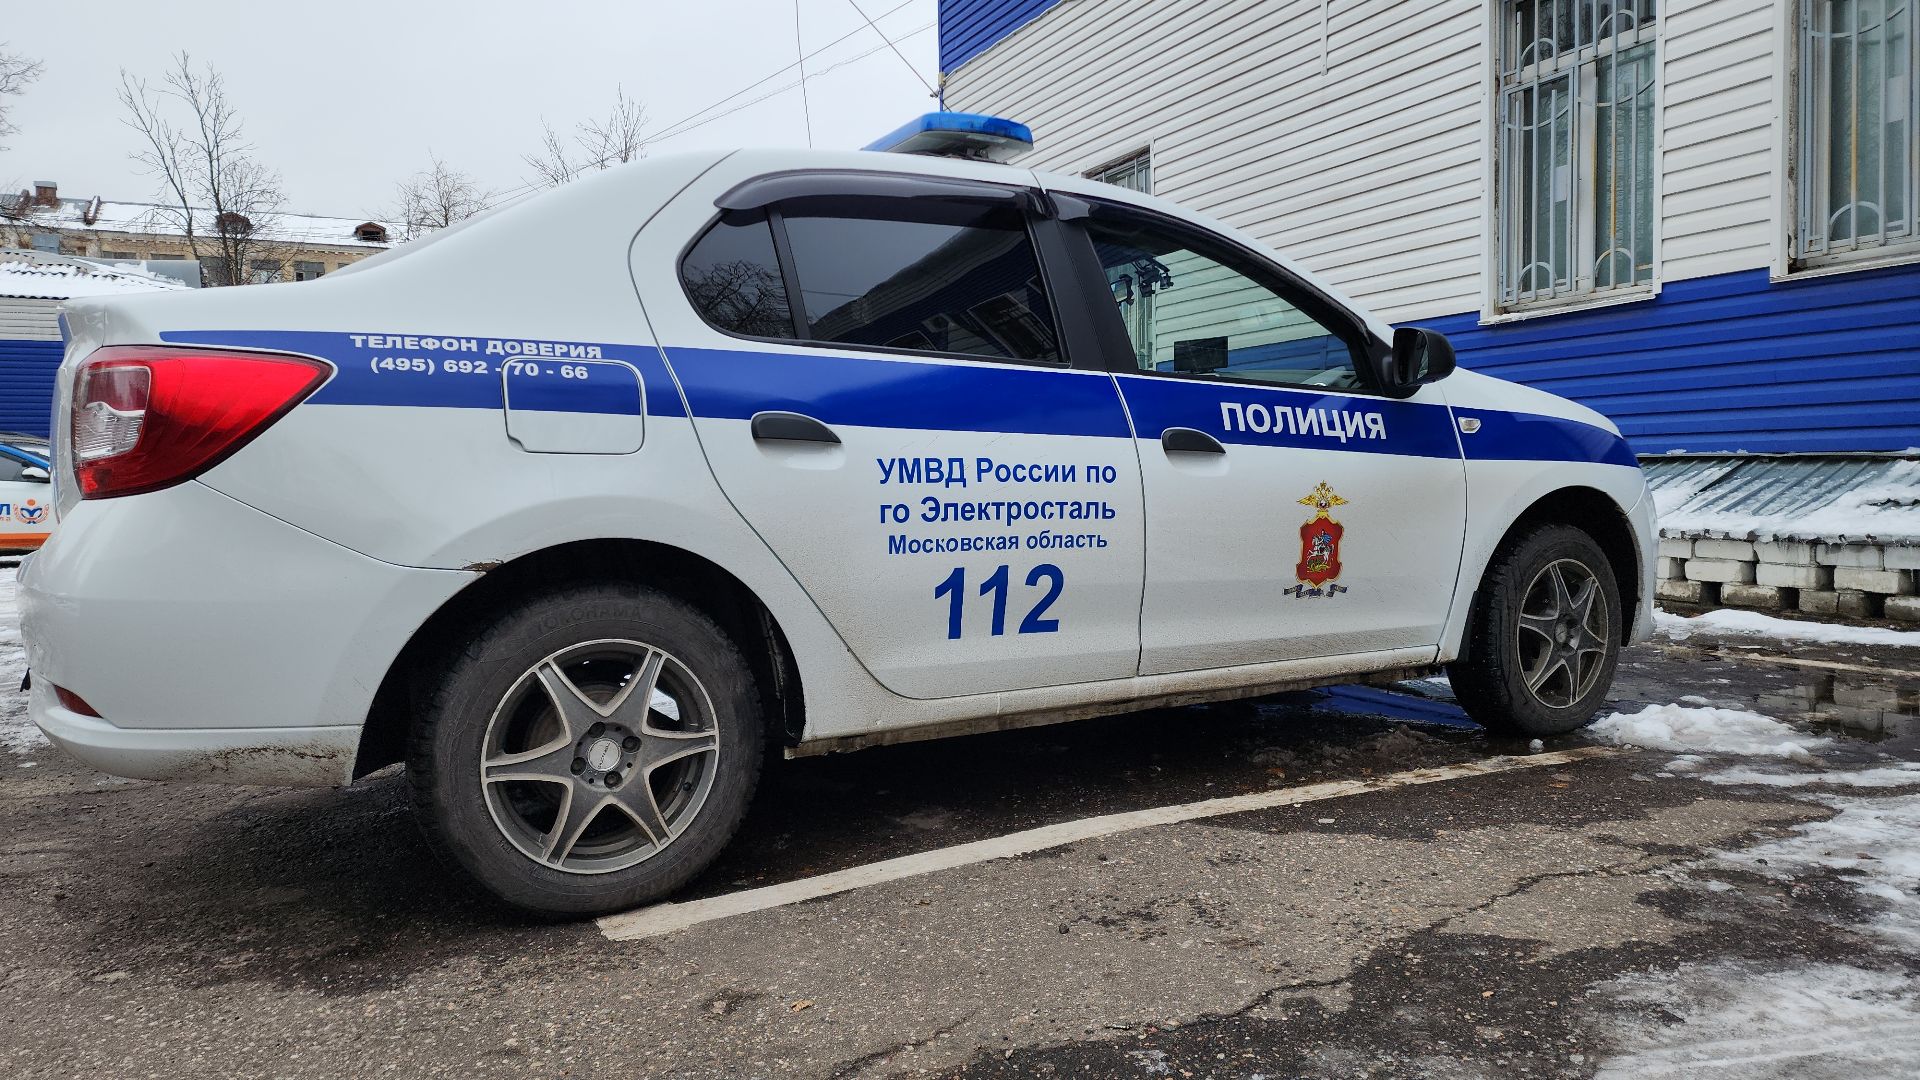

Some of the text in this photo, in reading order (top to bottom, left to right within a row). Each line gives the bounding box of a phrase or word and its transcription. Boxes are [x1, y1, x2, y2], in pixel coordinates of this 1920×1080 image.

[350, 335, 602, 359] ТЕЛЕФОН ДОВЕРИЯ
[370, 357, 435, 375] (495)
[443, 360, 488, 374] 692
[514, 362, 539, 377] 70
[560, 365, 589, 380] 66
[1220, 401, 1387, 444] ПОЛИЦИЯ
[876, 457, 1117, 488] УМВД России по
[880, 496, 1116, 526] го Электросталь
[888, 530, 1108, 554] Московская область
[934, 563, 1064, 640] 112
